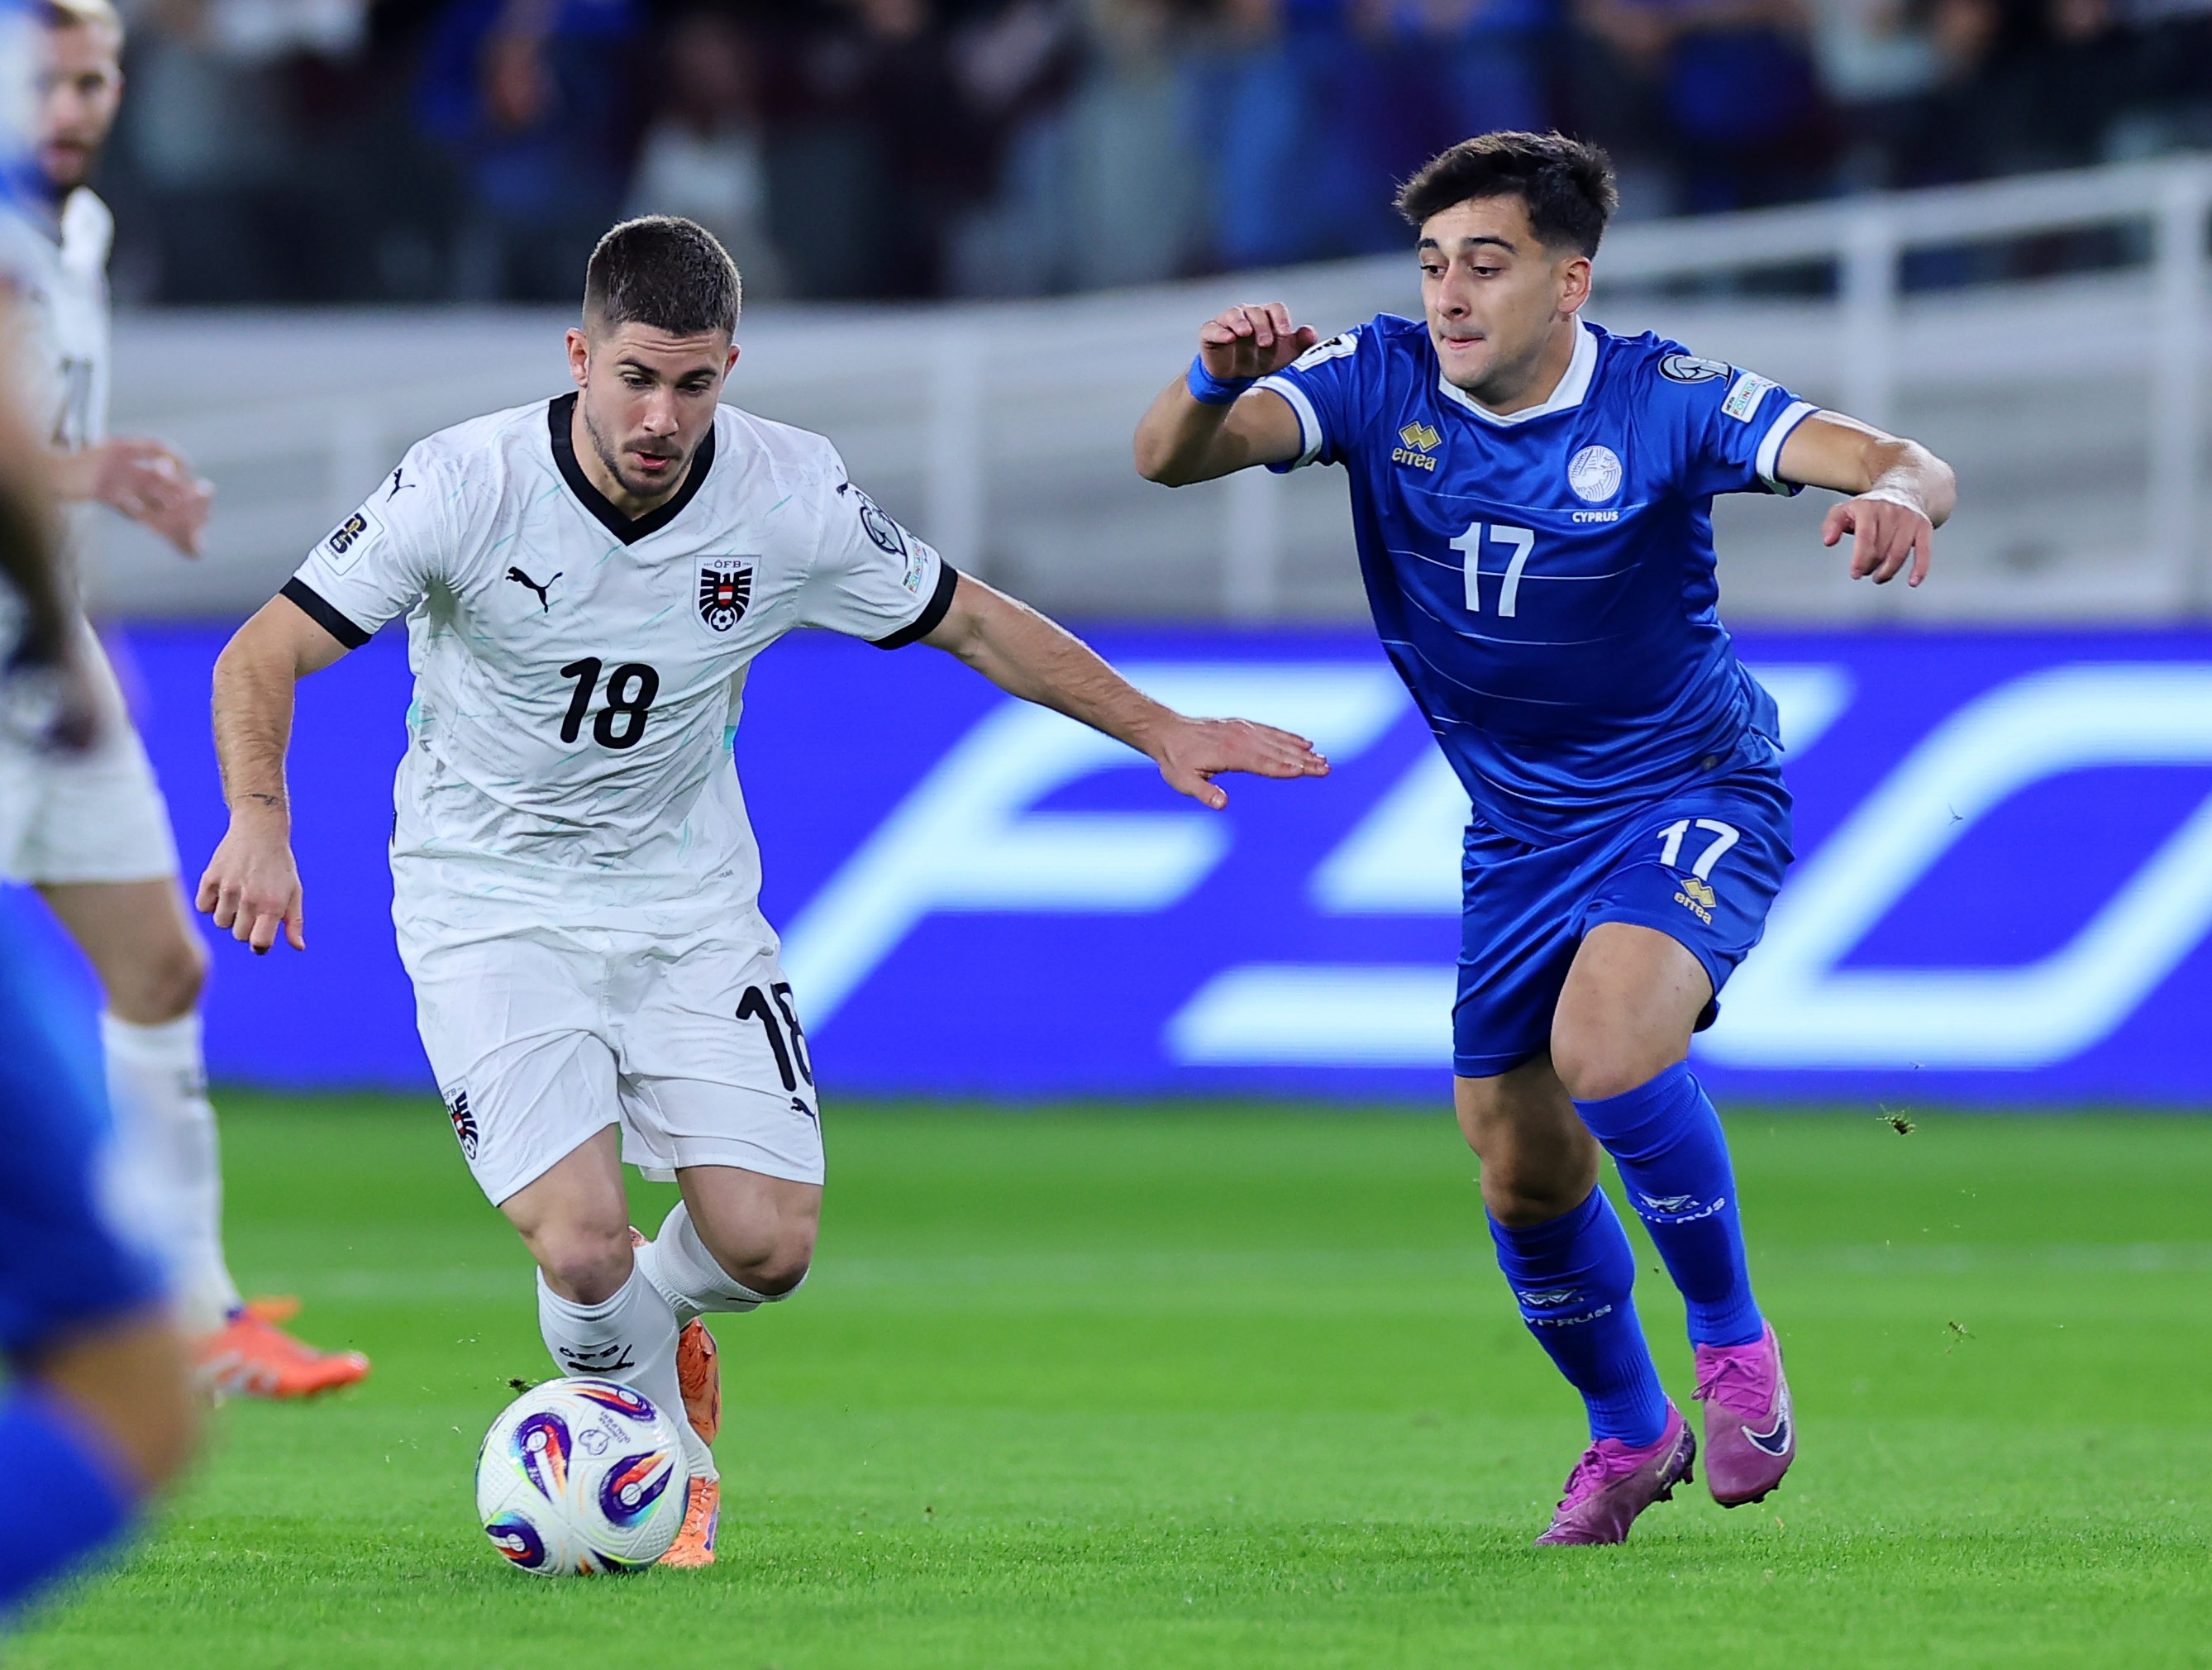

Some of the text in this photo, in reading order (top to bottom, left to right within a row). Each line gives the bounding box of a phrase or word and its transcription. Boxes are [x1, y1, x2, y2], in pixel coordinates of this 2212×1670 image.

[1572, 510, 1619, 522] CYPRUS
[713, 559, 741, 569] ÖFB
[1449, 522, 1535, 618] 17
[560, 656, 660, 750] 18
[1657, 818, 1740, 882] 17
